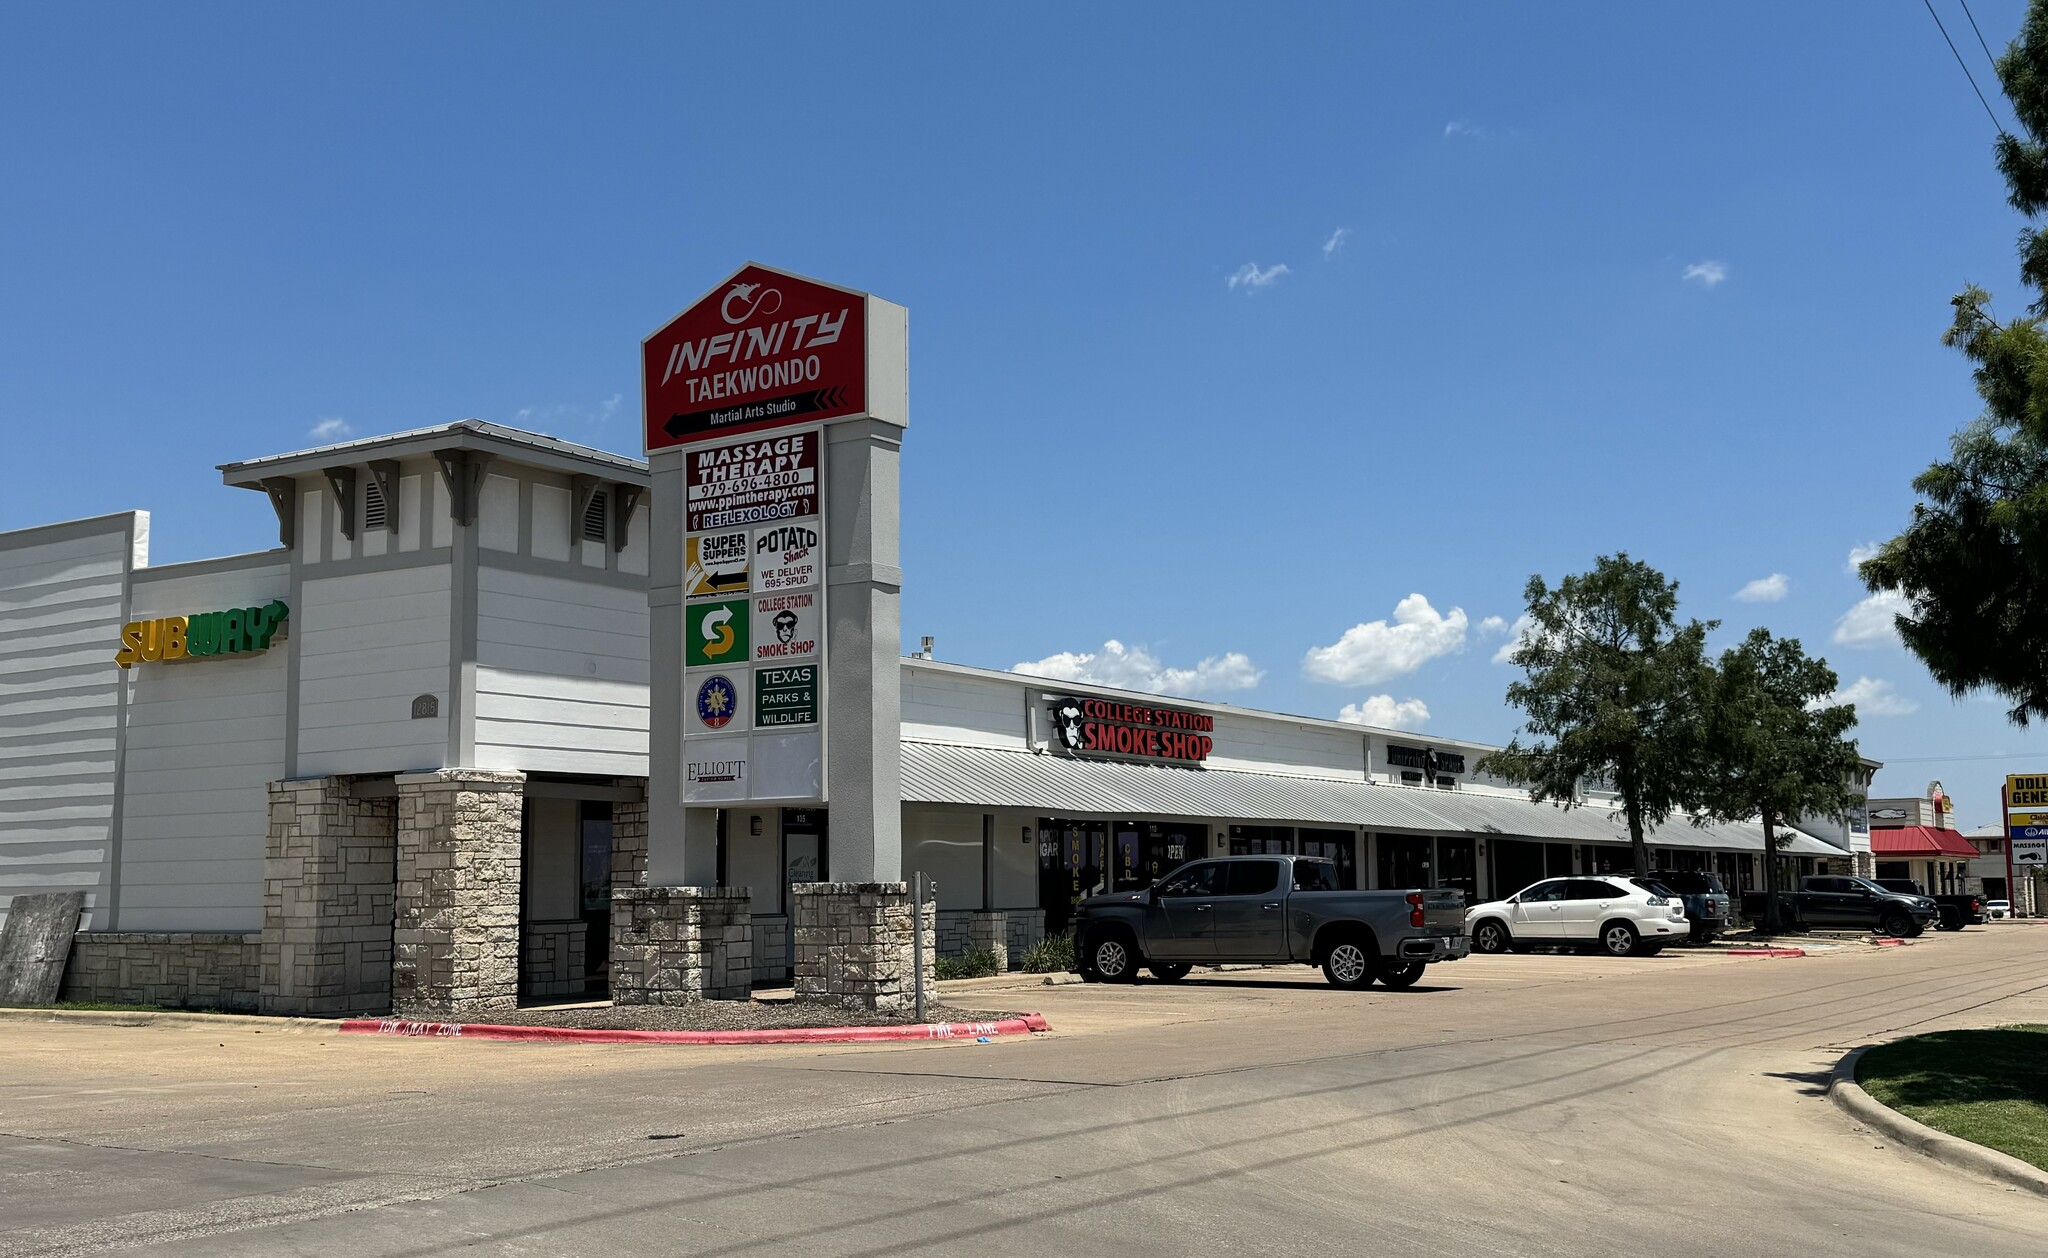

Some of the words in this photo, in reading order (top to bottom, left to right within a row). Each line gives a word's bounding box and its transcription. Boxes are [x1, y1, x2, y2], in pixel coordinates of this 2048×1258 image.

[660, 308, 849, 387] INFINITY
[686, 354, 820, 403] TAEKWONDO
[710, 406, 743, 425] Martial
[745, 404, 764, 420] Arts
[767, 399, 796, 415] Studio
[698, 436, 804, 469] MASSAGE
[698, 453, 803, 484] THERAPY
[701, 471, 800, 498] 979-696-4800
[688, 484, 815, 513] www.ppimtherapy.com
[703, 501, 799, 529] REFLEXOLOGY
[703, 533, 746, 551] SUPER
[756, 526, 818, 554] POTATO
[703, 546, 746, 561] SUPPERS
[783, 545, 809, 565] Shack
[761, 569, 775, 579] WE
[778, 565, 813, 577] DELIVER
[764, 575, 809, 589] 695-SPUD
[758, 597, 786, 613] COLLEGE
[786, 593, 813, 609] STATION
[114, 599, 290, 669] SUBWAY
[757, 642, 789, 658] SMOKE
[790, 639, 815, 655] SHOP
[762, 668, 812, 685] TEXAS
[762, 692, 799, 704] PARKS
[803, 691, 811, 701] &
[762, 712, 812, 725] WILDLIFE
[1084, 699, 1153, 724] COLLEGE
[1155, 711, 1214, 732] STATION
[1084, 722, 1157, 755] SMOKE
[1161, 731, 1213, 762] SHOP
[688, 760, 746, 781] ELLIOTT
[1039, 842, 1059, 857] IGAR
[1071, 826, 1081, 892] SMOKE
[378, 1021, 400, 1033] TOW
[436, 1022, 465, 1036] ZONE
[928, 1024, 954, 1037] FIRE
[966, 1023, 998, 1035] LANE
